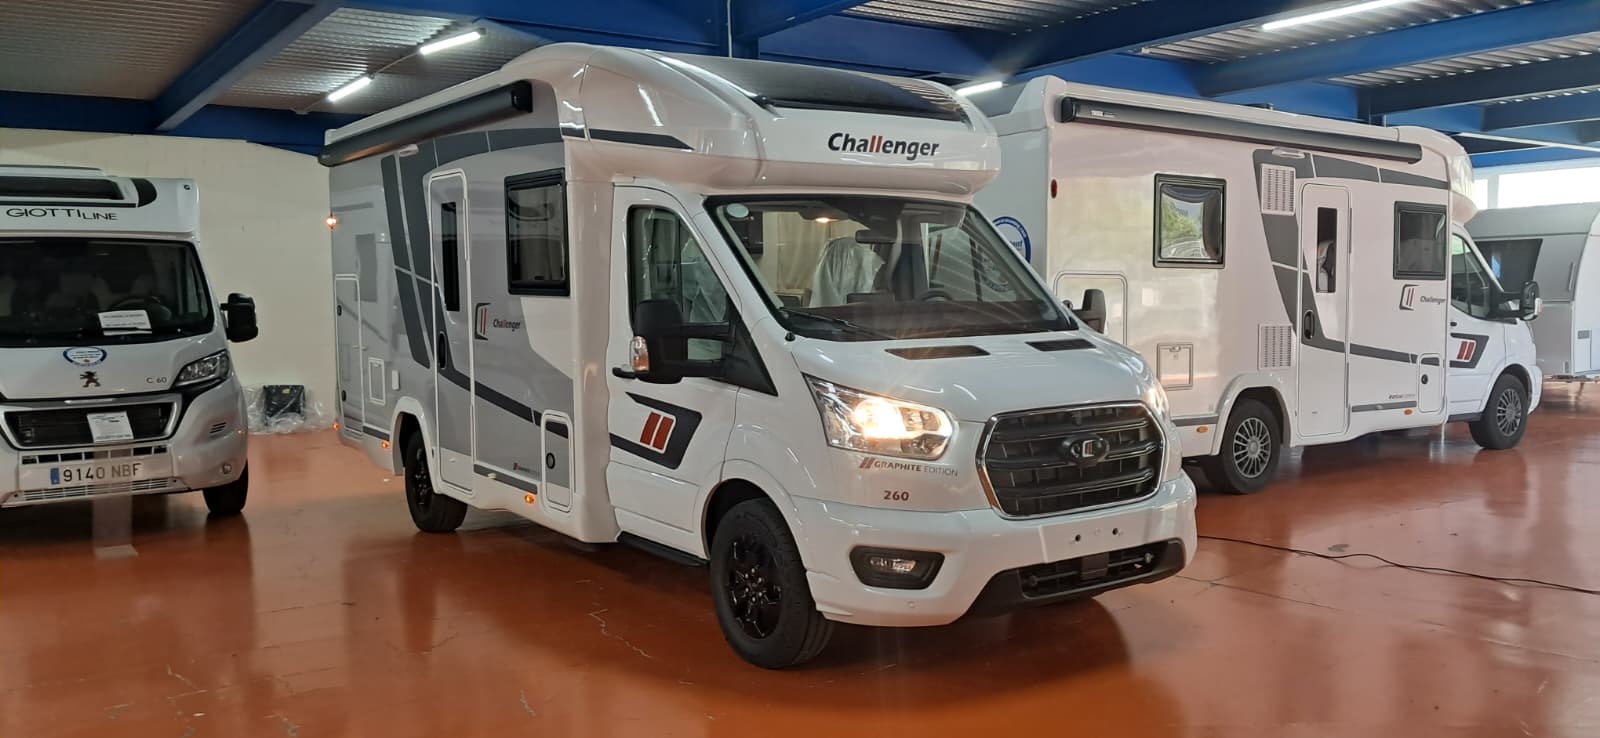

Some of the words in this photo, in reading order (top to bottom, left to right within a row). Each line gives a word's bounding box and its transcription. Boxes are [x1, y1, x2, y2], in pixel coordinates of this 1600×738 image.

[827, 132, 940, 160] Challenger
[6, 208, 119, 220] GIOTTILINE
[493, 318, 521, 332] Challenger
[63, 466, 105, 482] 9140
[111, 462, 141, 477] NBF
[874, 460, 921, 472] GRAPHITE
[923, 466, 958, 477] EDITION
[883, 490, 910, 501] 260
